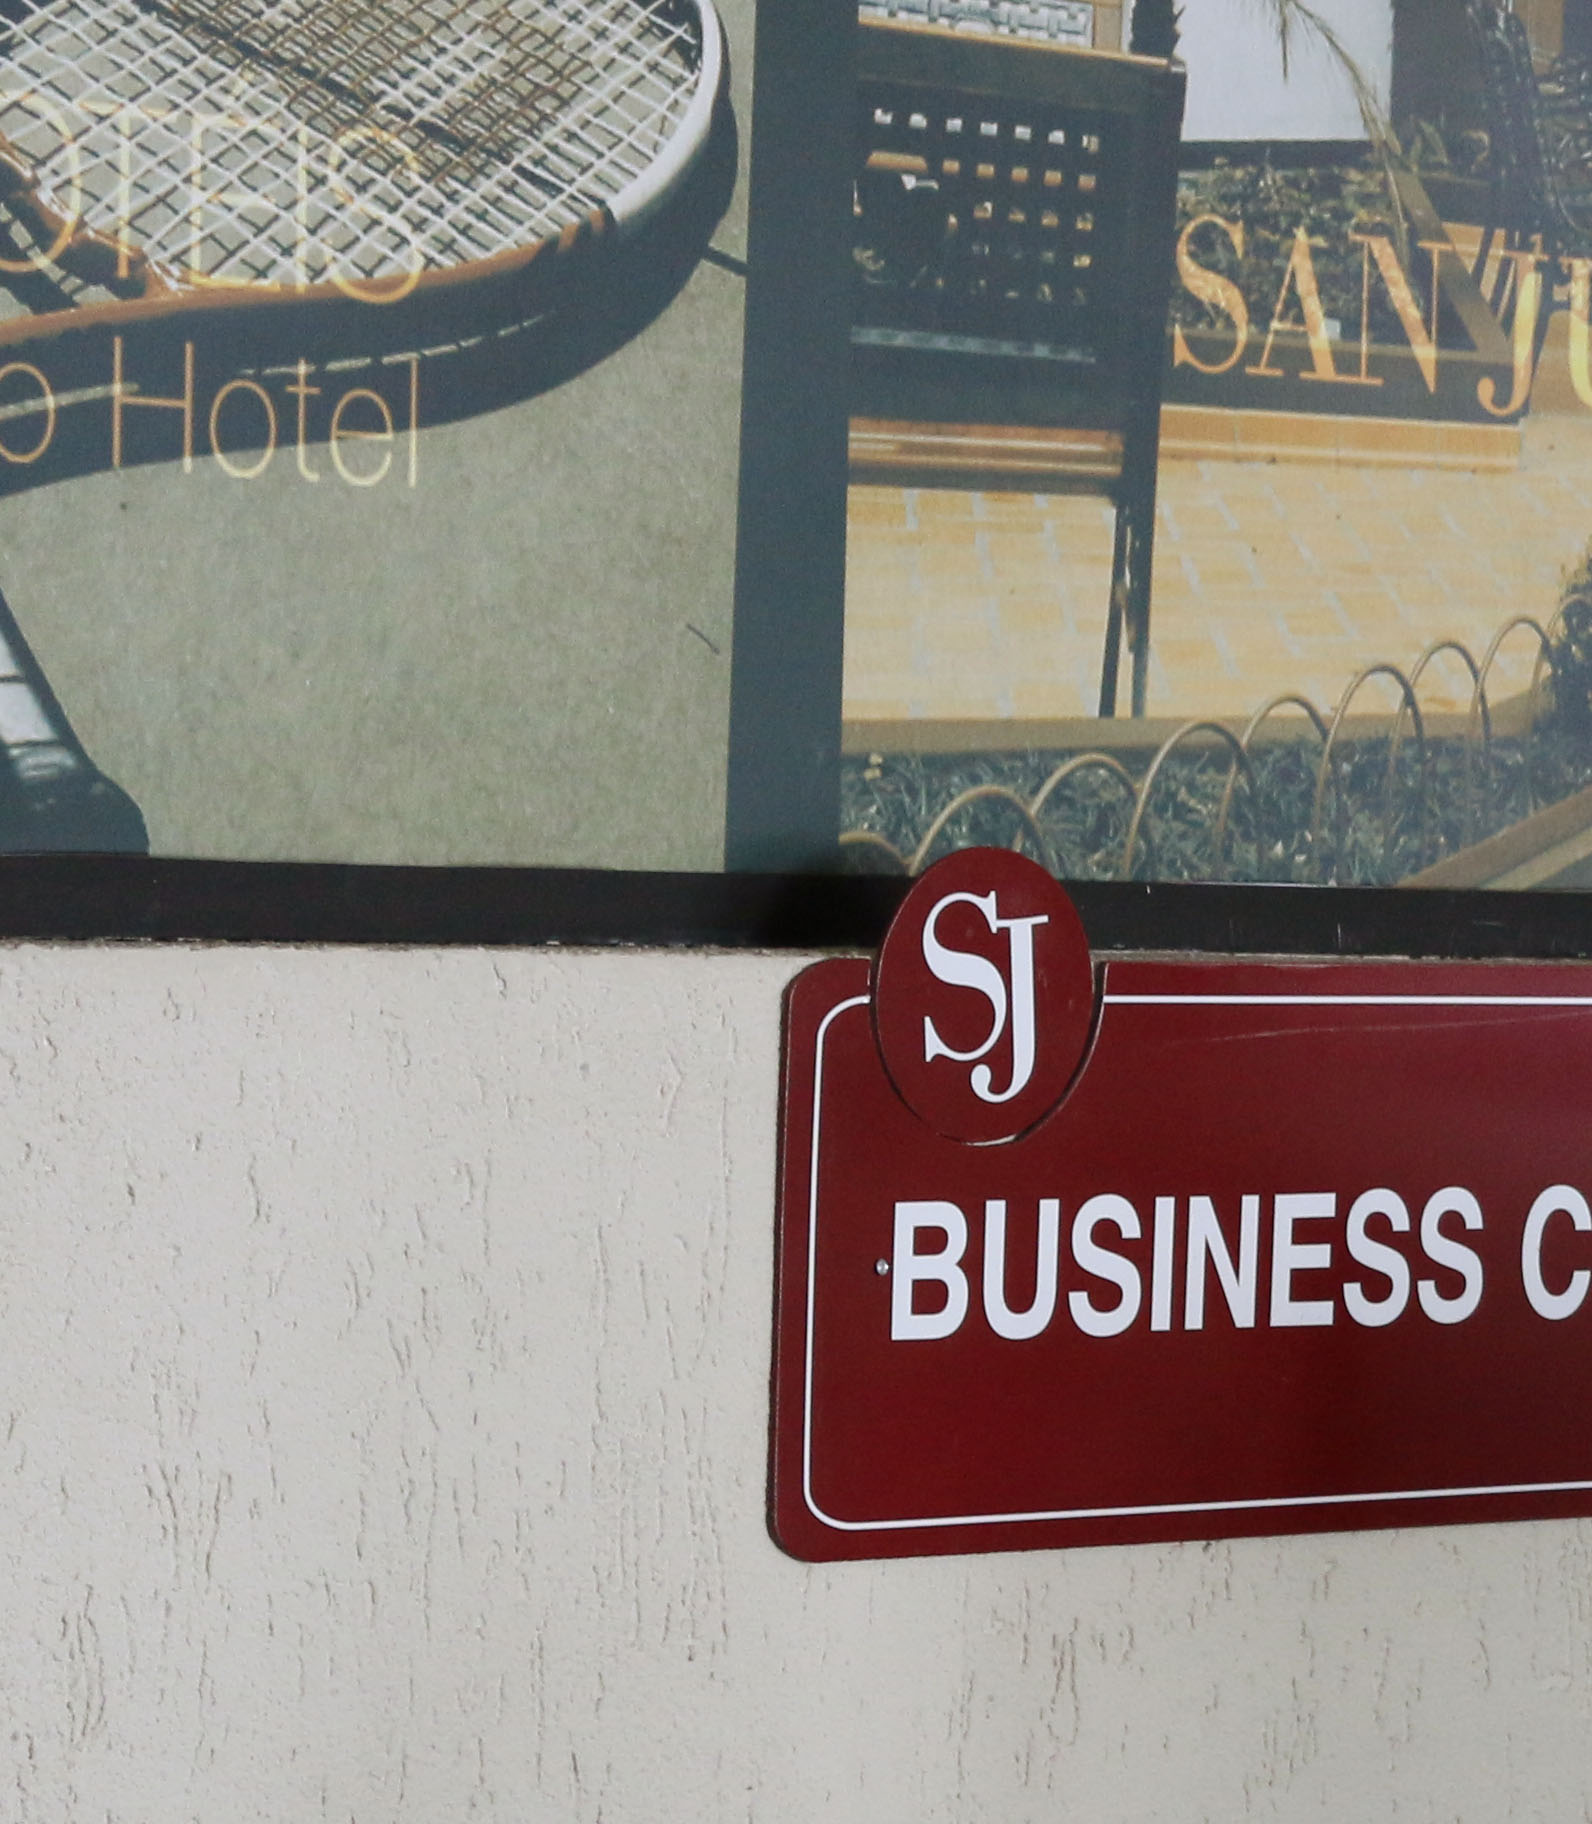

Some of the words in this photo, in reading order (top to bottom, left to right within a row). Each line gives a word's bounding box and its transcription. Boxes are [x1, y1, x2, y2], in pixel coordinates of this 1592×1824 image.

[1172, 214, 1464, 394] SAN
[113, 336, 421, 489] Hotel
[920, 890, 1050, 1104] SJ
[887, 1186, 1484, 1342] BUSINESS
